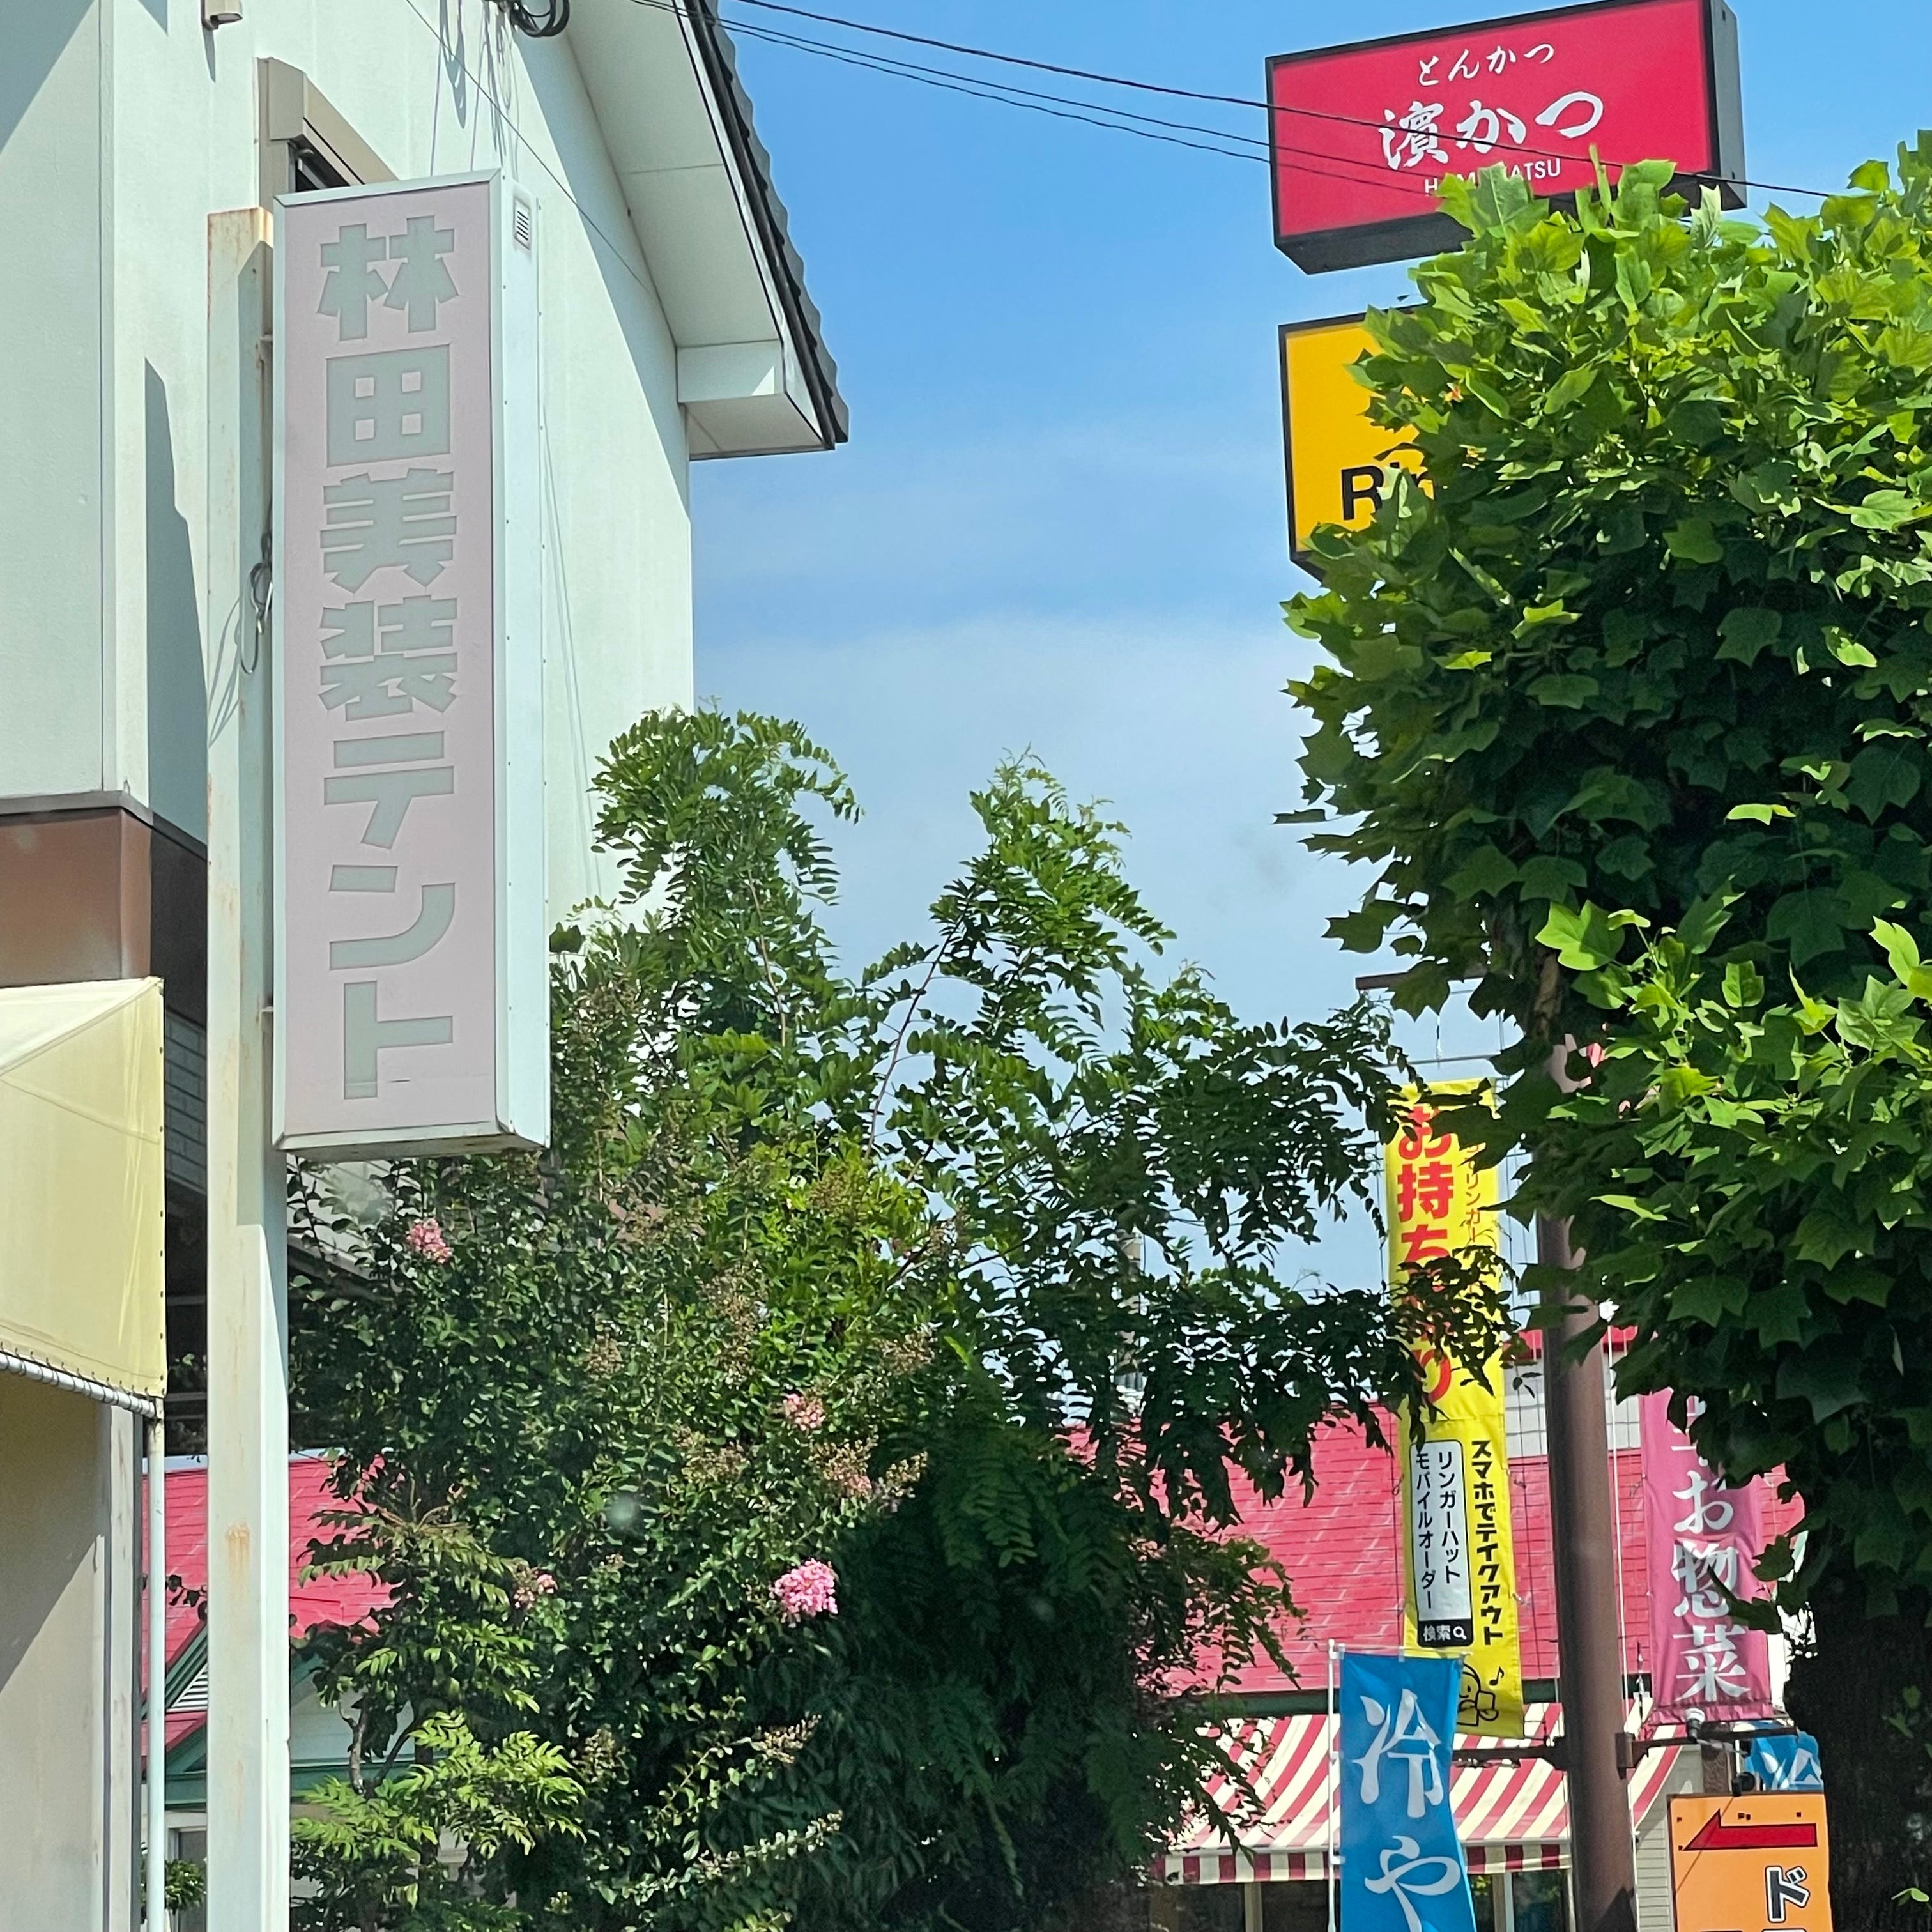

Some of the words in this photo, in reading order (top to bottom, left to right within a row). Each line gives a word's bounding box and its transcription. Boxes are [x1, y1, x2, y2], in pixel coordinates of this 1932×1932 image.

[1379, 90, 1605, 171] 濱かつ
[1418, 42, 1555, 87] とんかつ
[1424, 158, 1561, 194] HMATSU
[316, 214, 459, 1101] 林田美装テント
[1397, 1105, 1454, 1404] お持ちり
[1416, 1452, 1436, 1609] モバイルオーダー
[1438, 1451, 1460, 1584] リンガーハット
[1471, 1439, 1503, 1646] スマホでテイクアウト
[1671, 1395, 1751, 1703] お惣菜
[1423, 1624, 1452, 1642] 検索
[1351, 1688, 1461, 1932] 冷や
[1761, 1865, 1811, 1932] ド
